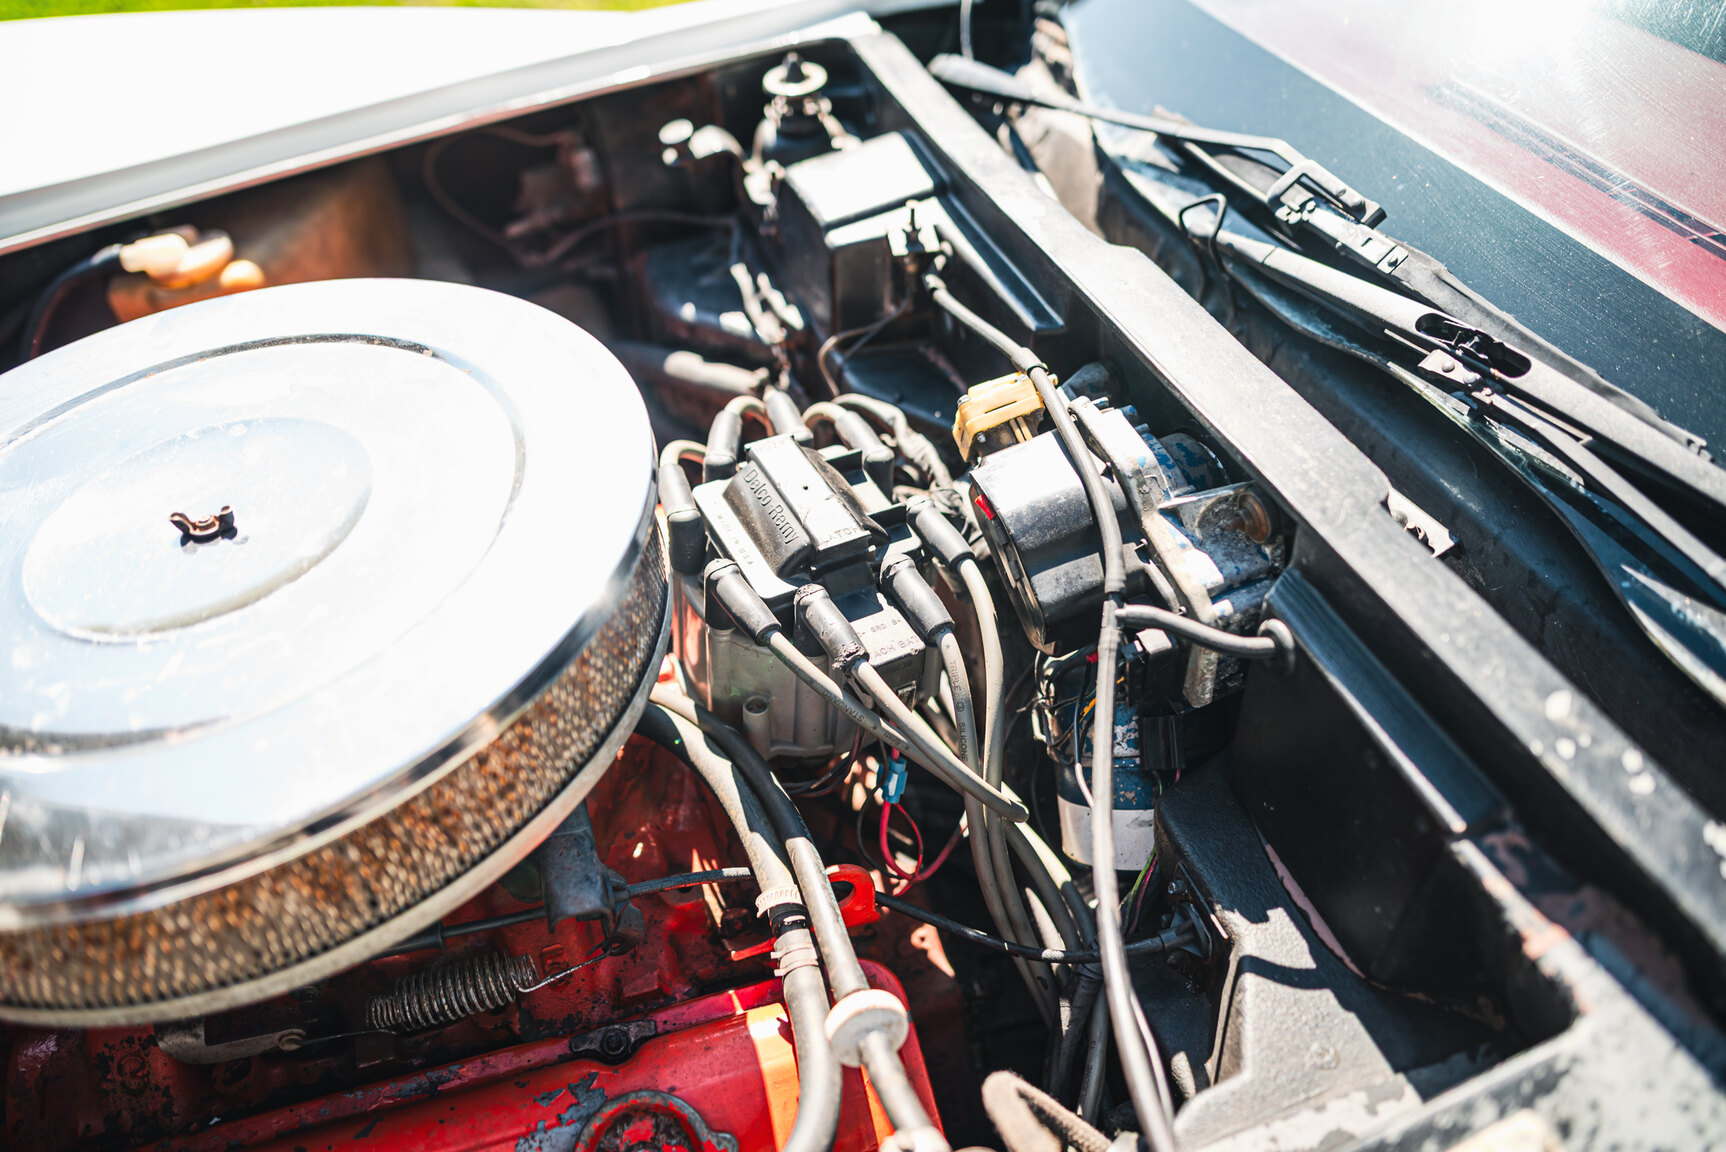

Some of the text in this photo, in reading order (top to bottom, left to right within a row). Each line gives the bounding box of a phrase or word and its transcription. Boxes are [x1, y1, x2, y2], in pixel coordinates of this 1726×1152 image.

[743, 468, 800, 545] Delco-Remy
[822, 687, 865, 723] STANDARD
[949, 660, 962, 693] TRIPLE
[958, 721, 969, 762] SILICONE
